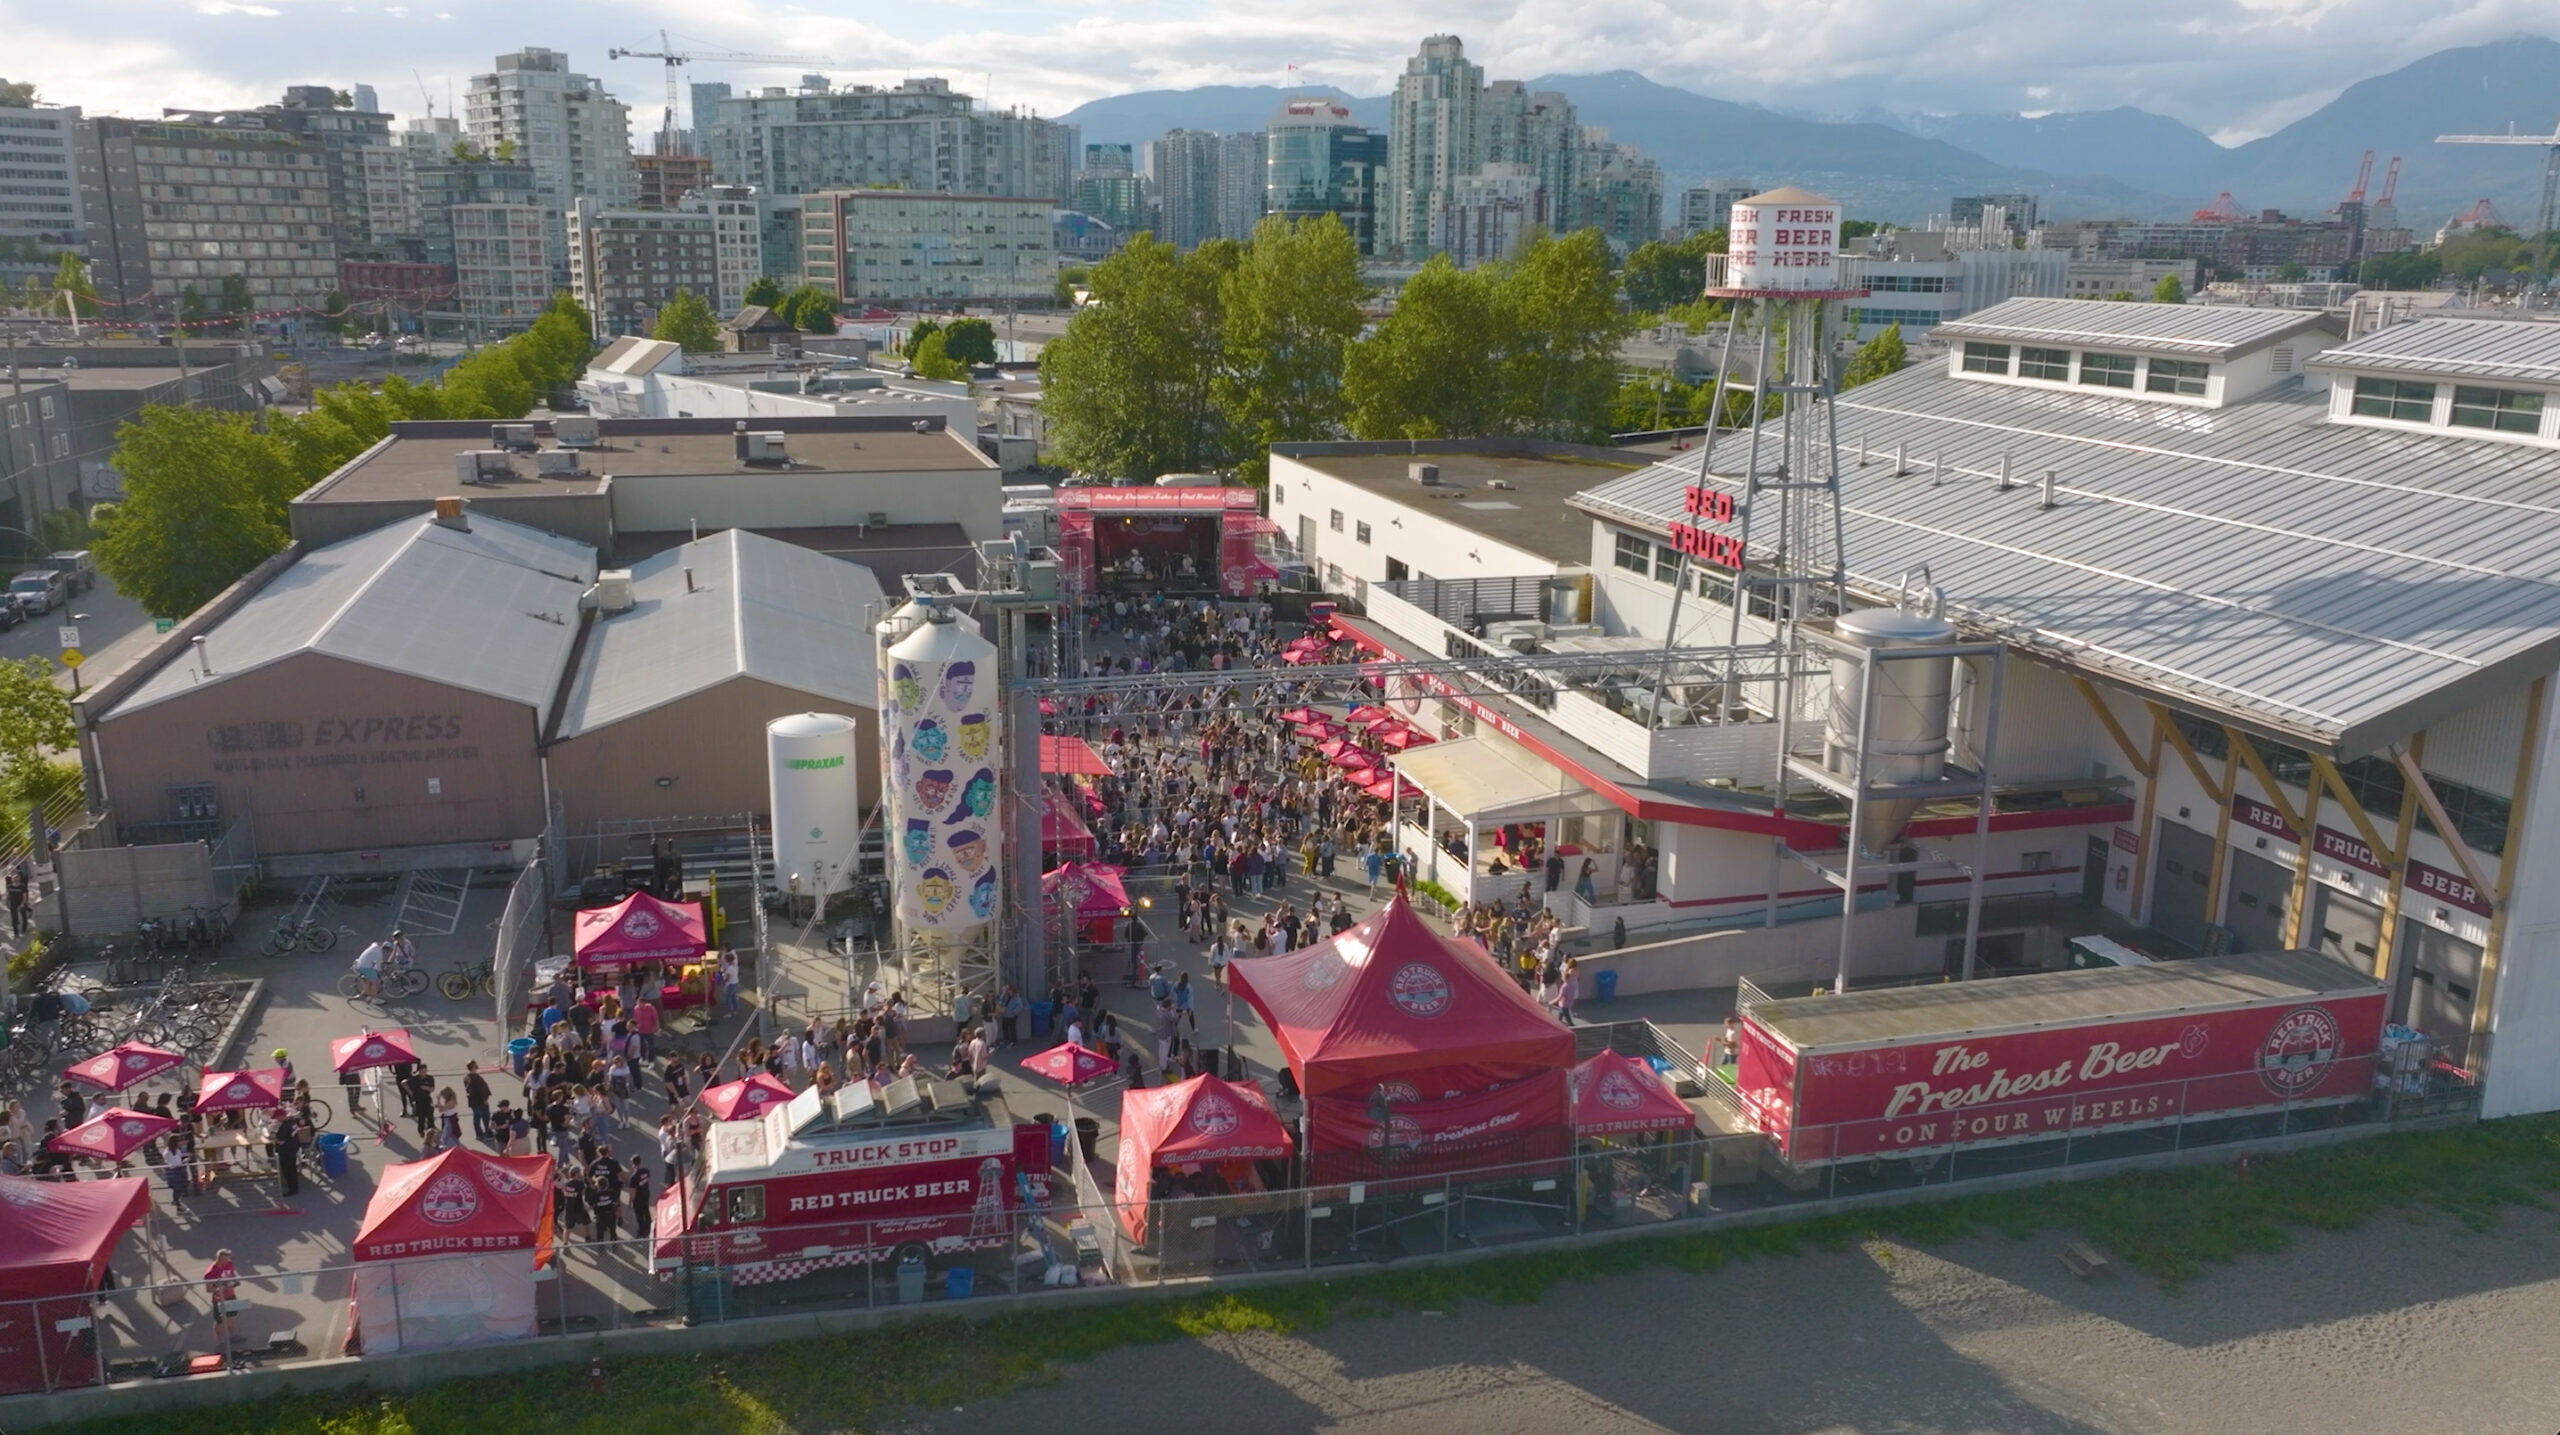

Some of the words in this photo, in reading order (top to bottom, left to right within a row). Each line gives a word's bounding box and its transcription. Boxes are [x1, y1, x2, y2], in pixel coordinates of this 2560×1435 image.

[1776, 210, 1834, 223] FRESH
[1774, 229, 1832, 245] BEER
[1773, 251, 1831, 267] HERE
[1683, 485, 1733, 523] RED
[1668, 520, 1747, 571] TRUCK
[63, 632, 77, 642] 30
[314, 714, 464, 747] EXPRESS
[800, 756, 845, 769] PRAXAIR
[2250, 806, 2284, 831] RED
[2322, 832, 2382, 869] TRUCK
[2421, 870, 2477, 905] BEER
[1396, 970, 1411, 989] RED
[1410, 966, 1442, 985] TRUCK
[1411, 1001, 1440, 1011] BEER
[2271, 1019, 2295, 1049] RED
[2297, 1014, 2333, 1044] TRUCK
[1932, 1045, 1990, 1076] The
[1884, 1060, 2072, 1121] Freshest
[2078, 1041, 2181, 1081] Beer
[2277, 1066, 2315, 1084] BEER
[1433, 1123, 1488, 1143] Freshest
[1489, 1111, 1521, 1129] Beer
[1579, 1124, 1604, 1133] RED
[1605, 1120, 1649, 1131] TRUCK
[1651, 1117, 1687, 1127] BEER
[1896, 1123, 1937, 1144] ON
[1951, 1113, 2030, 1138] FOUR
[2044, 1096, 2160, 1125] WHEELS
[812, 1144, 892, 1167] TRUCK
[898, 1138, 958, 1157] STOP
[429, 1179, 446, 1200] RED
[447, 1177, 474, 1200] TRUCK
[790, 1194, 835, 1212] RED
[838, 1185, 910, 1207] TRUCK
[914, 1179, 970, 1198] BEER
[434, 1209, 464, 1218] BEER
[369, 1243, 406, 1256] RED
[409, 1238, 468, 1251] TRUCK
[472, 1236, 520, 1247] BEER
